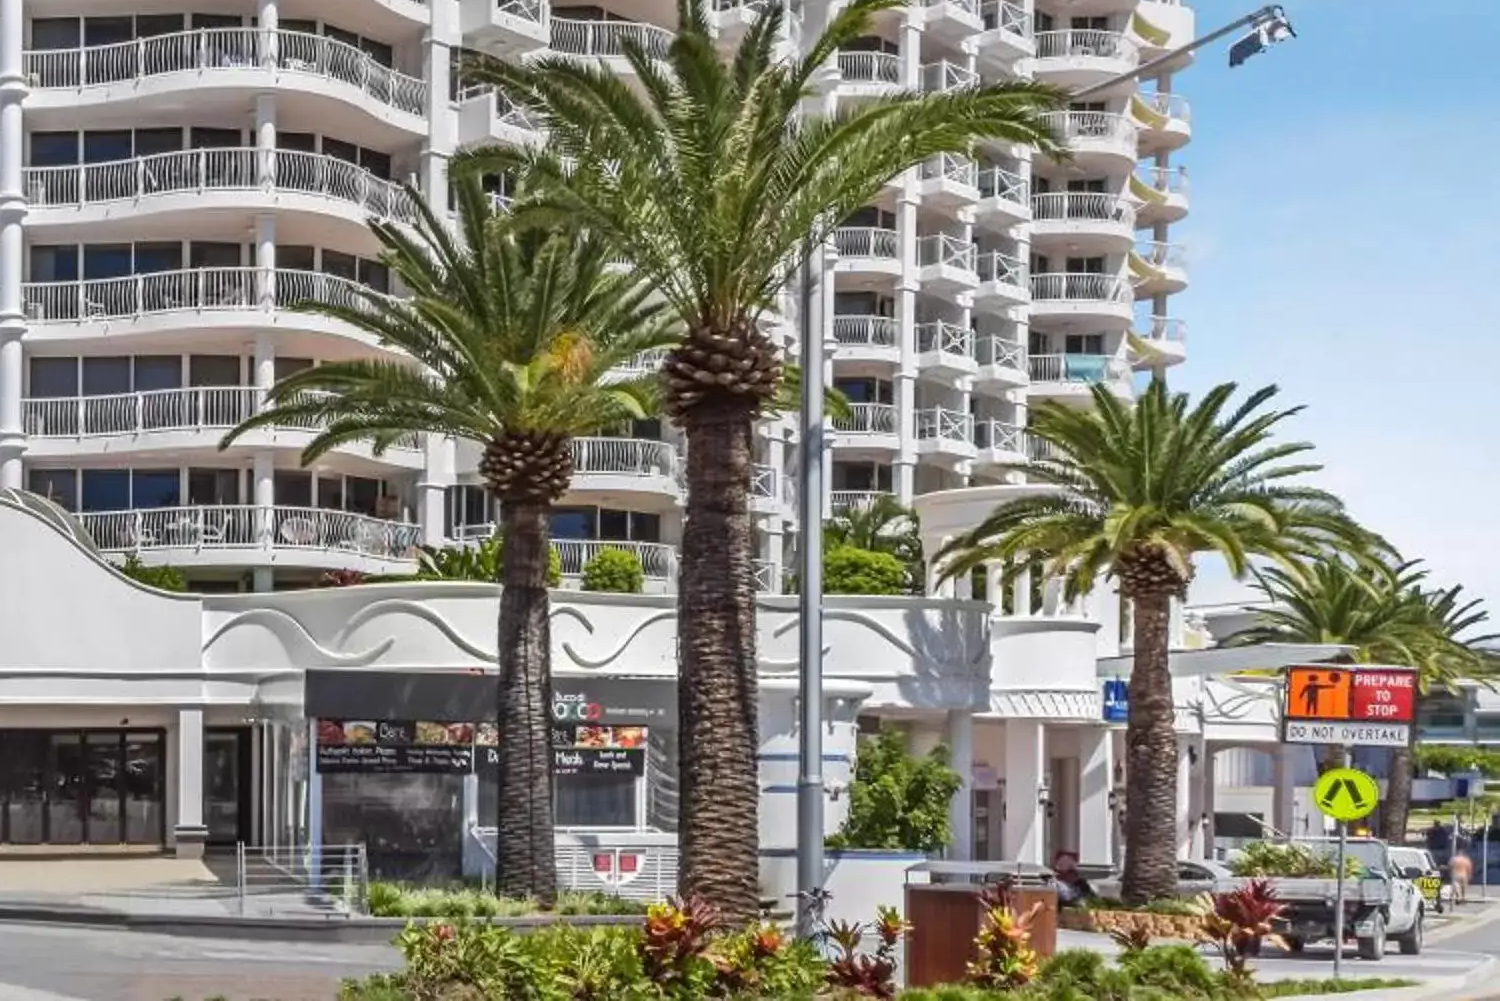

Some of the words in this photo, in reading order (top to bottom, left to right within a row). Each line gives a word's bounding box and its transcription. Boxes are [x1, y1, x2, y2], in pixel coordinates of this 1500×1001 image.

[1355, 673, 1413, 688] PREPARE
[1375, 688, 1392, 702] TO
[1366, 703, 1398, 716] STOP
[1289, 725, 1307, 738] DO
[1311, 726, 1336, 739] NOT
[1341, 727, 1405, 741] OVERTAKE
